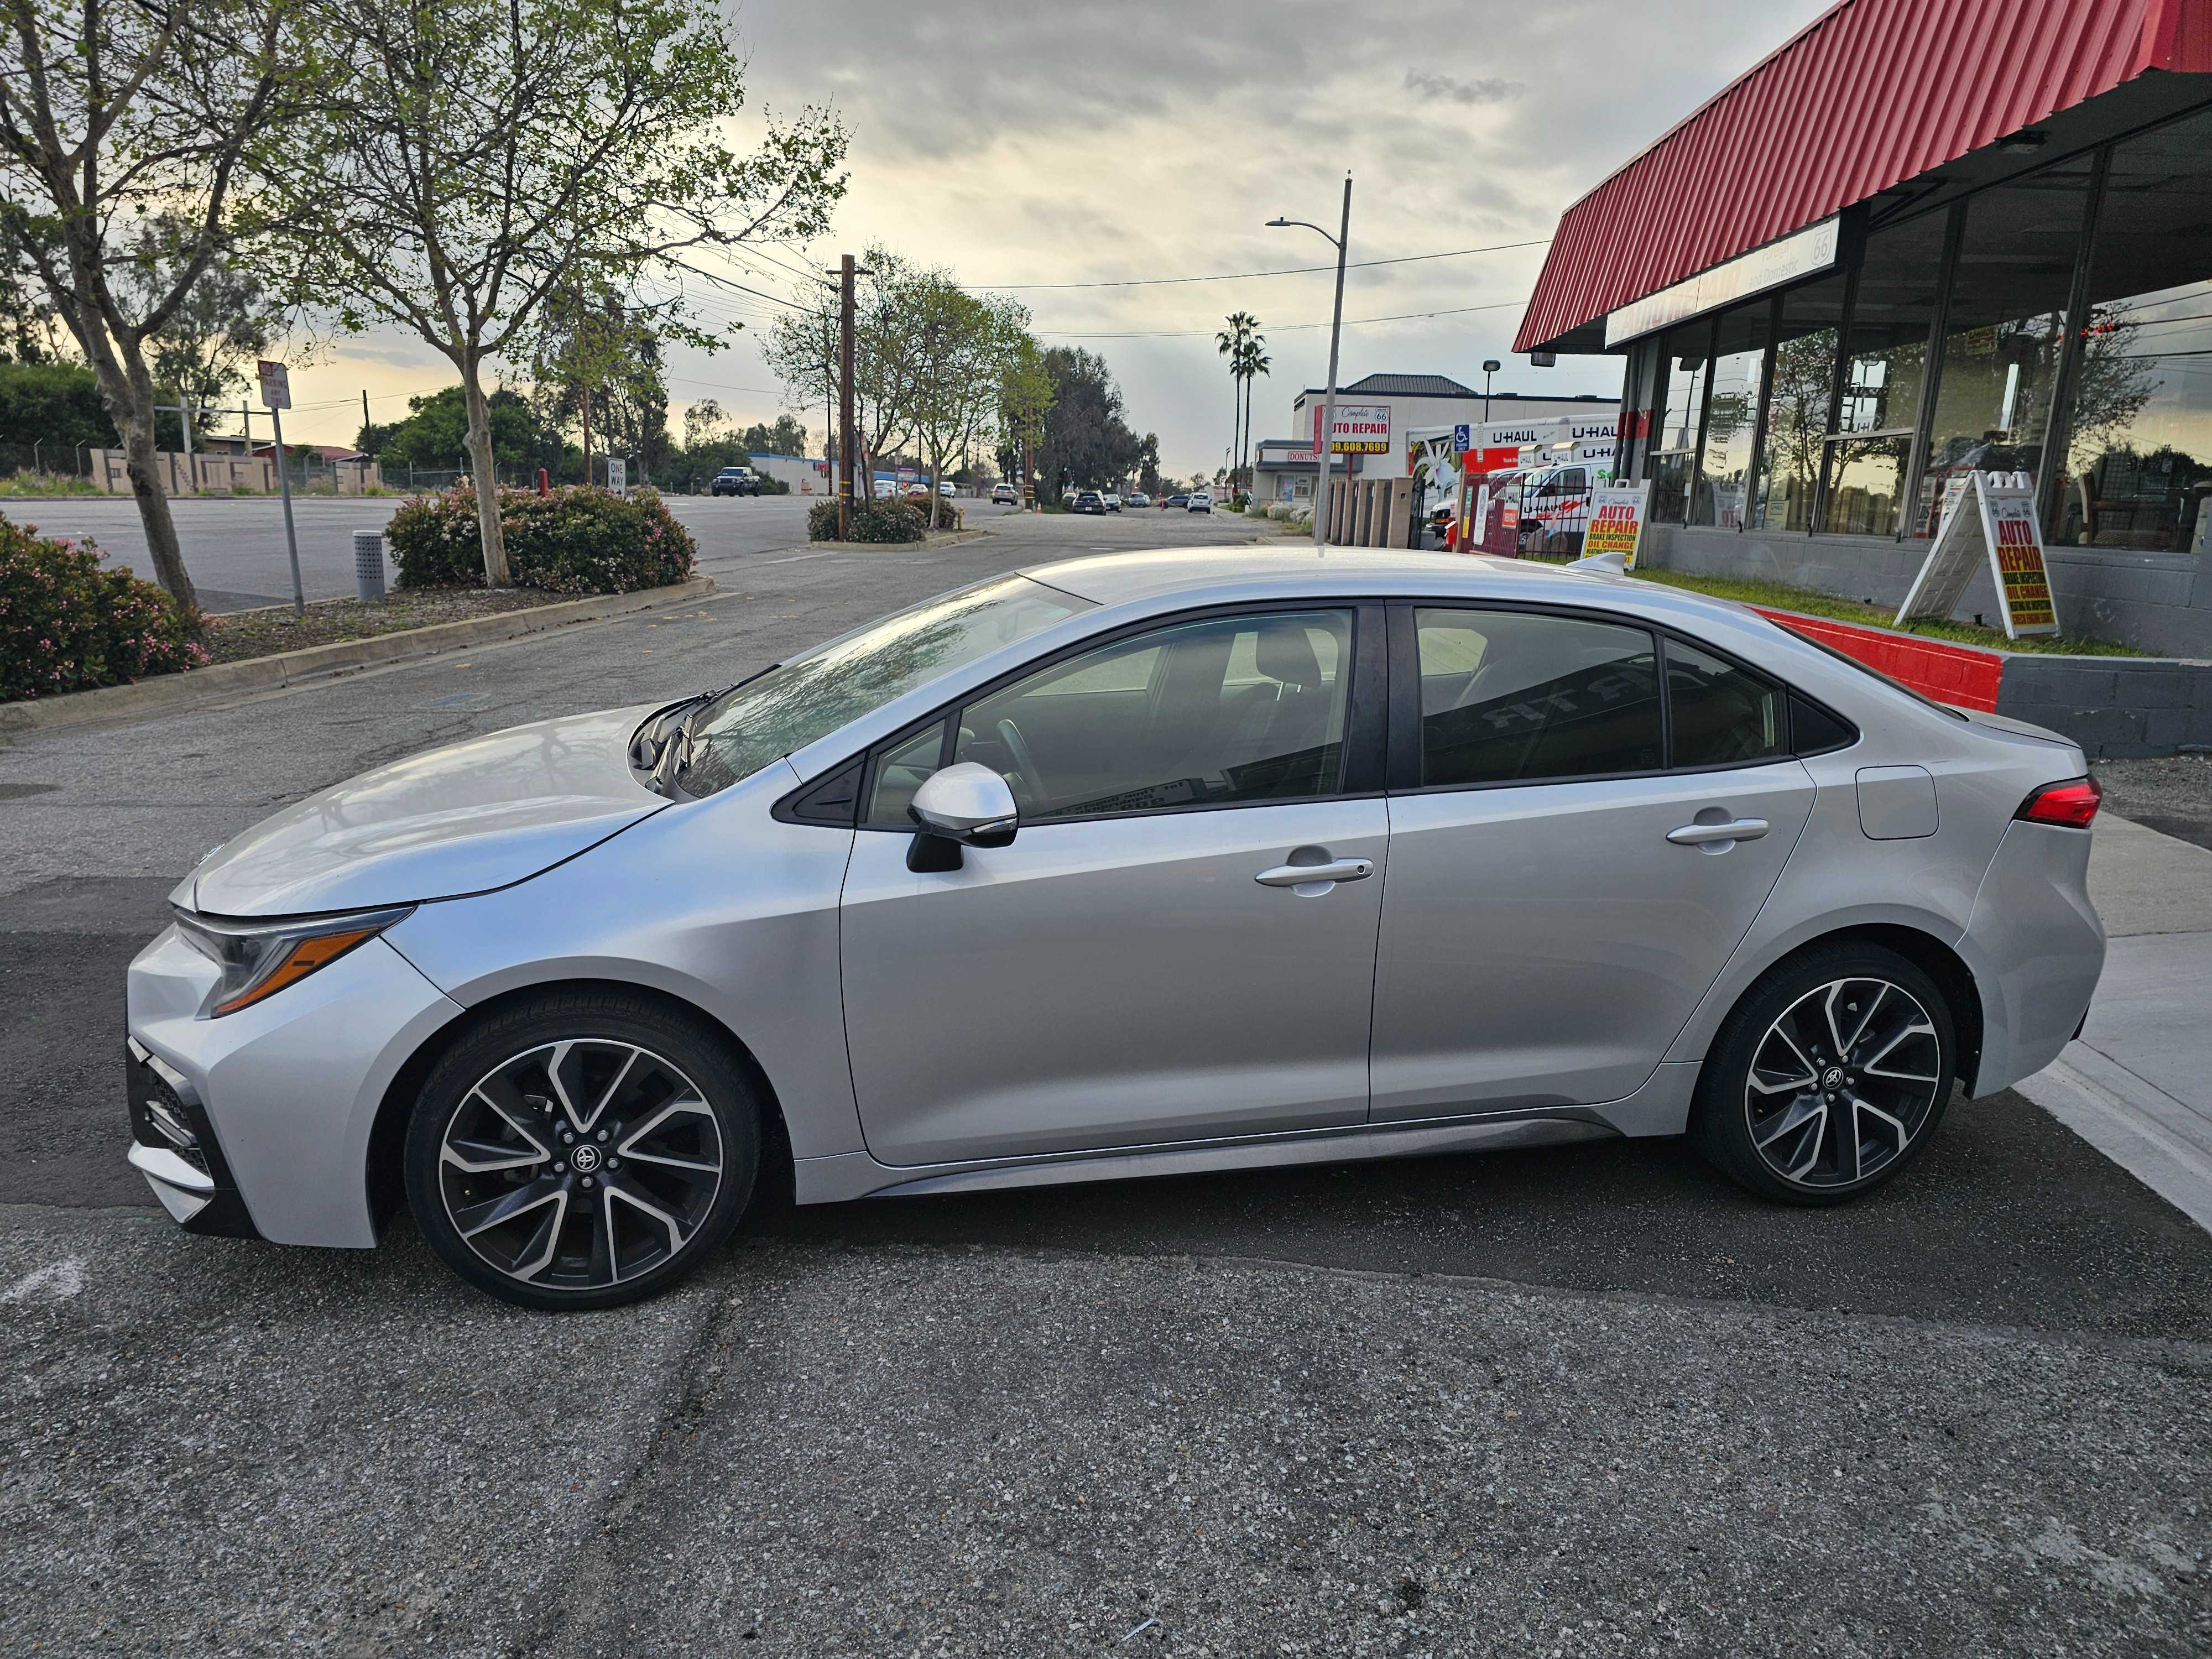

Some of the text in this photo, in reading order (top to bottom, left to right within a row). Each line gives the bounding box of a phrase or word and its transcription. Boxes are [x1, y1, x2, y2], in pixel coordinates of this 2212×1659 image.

[1813, 236, 1828, 258] 66
[1764, 258, 1798, 284] Domestic
[1332, 422, 1387, 434] UTO REPAIR
[1572, 426, 1618, 438] U-HA
[1331, 442, 1387, 451] 09.608.7699
[1290, 452, 1317, 461] DONUTS
[611, 463, 623, 473] ONE
[611, 476, 623, 486] WAY
[1598, 505, 1635, 520] AUTO
[1590, 519, 1639, 534] REPAIR
[1998, 520, 2032, 545] AUTO
[1606, 534, 1636, 542] INSPECTION
[1601, 541, 1634, 550] CHANGE
[1996, 546, 2044, 571] REPAIR
[2007, 586, 2048, 599] OIL CHANGE
